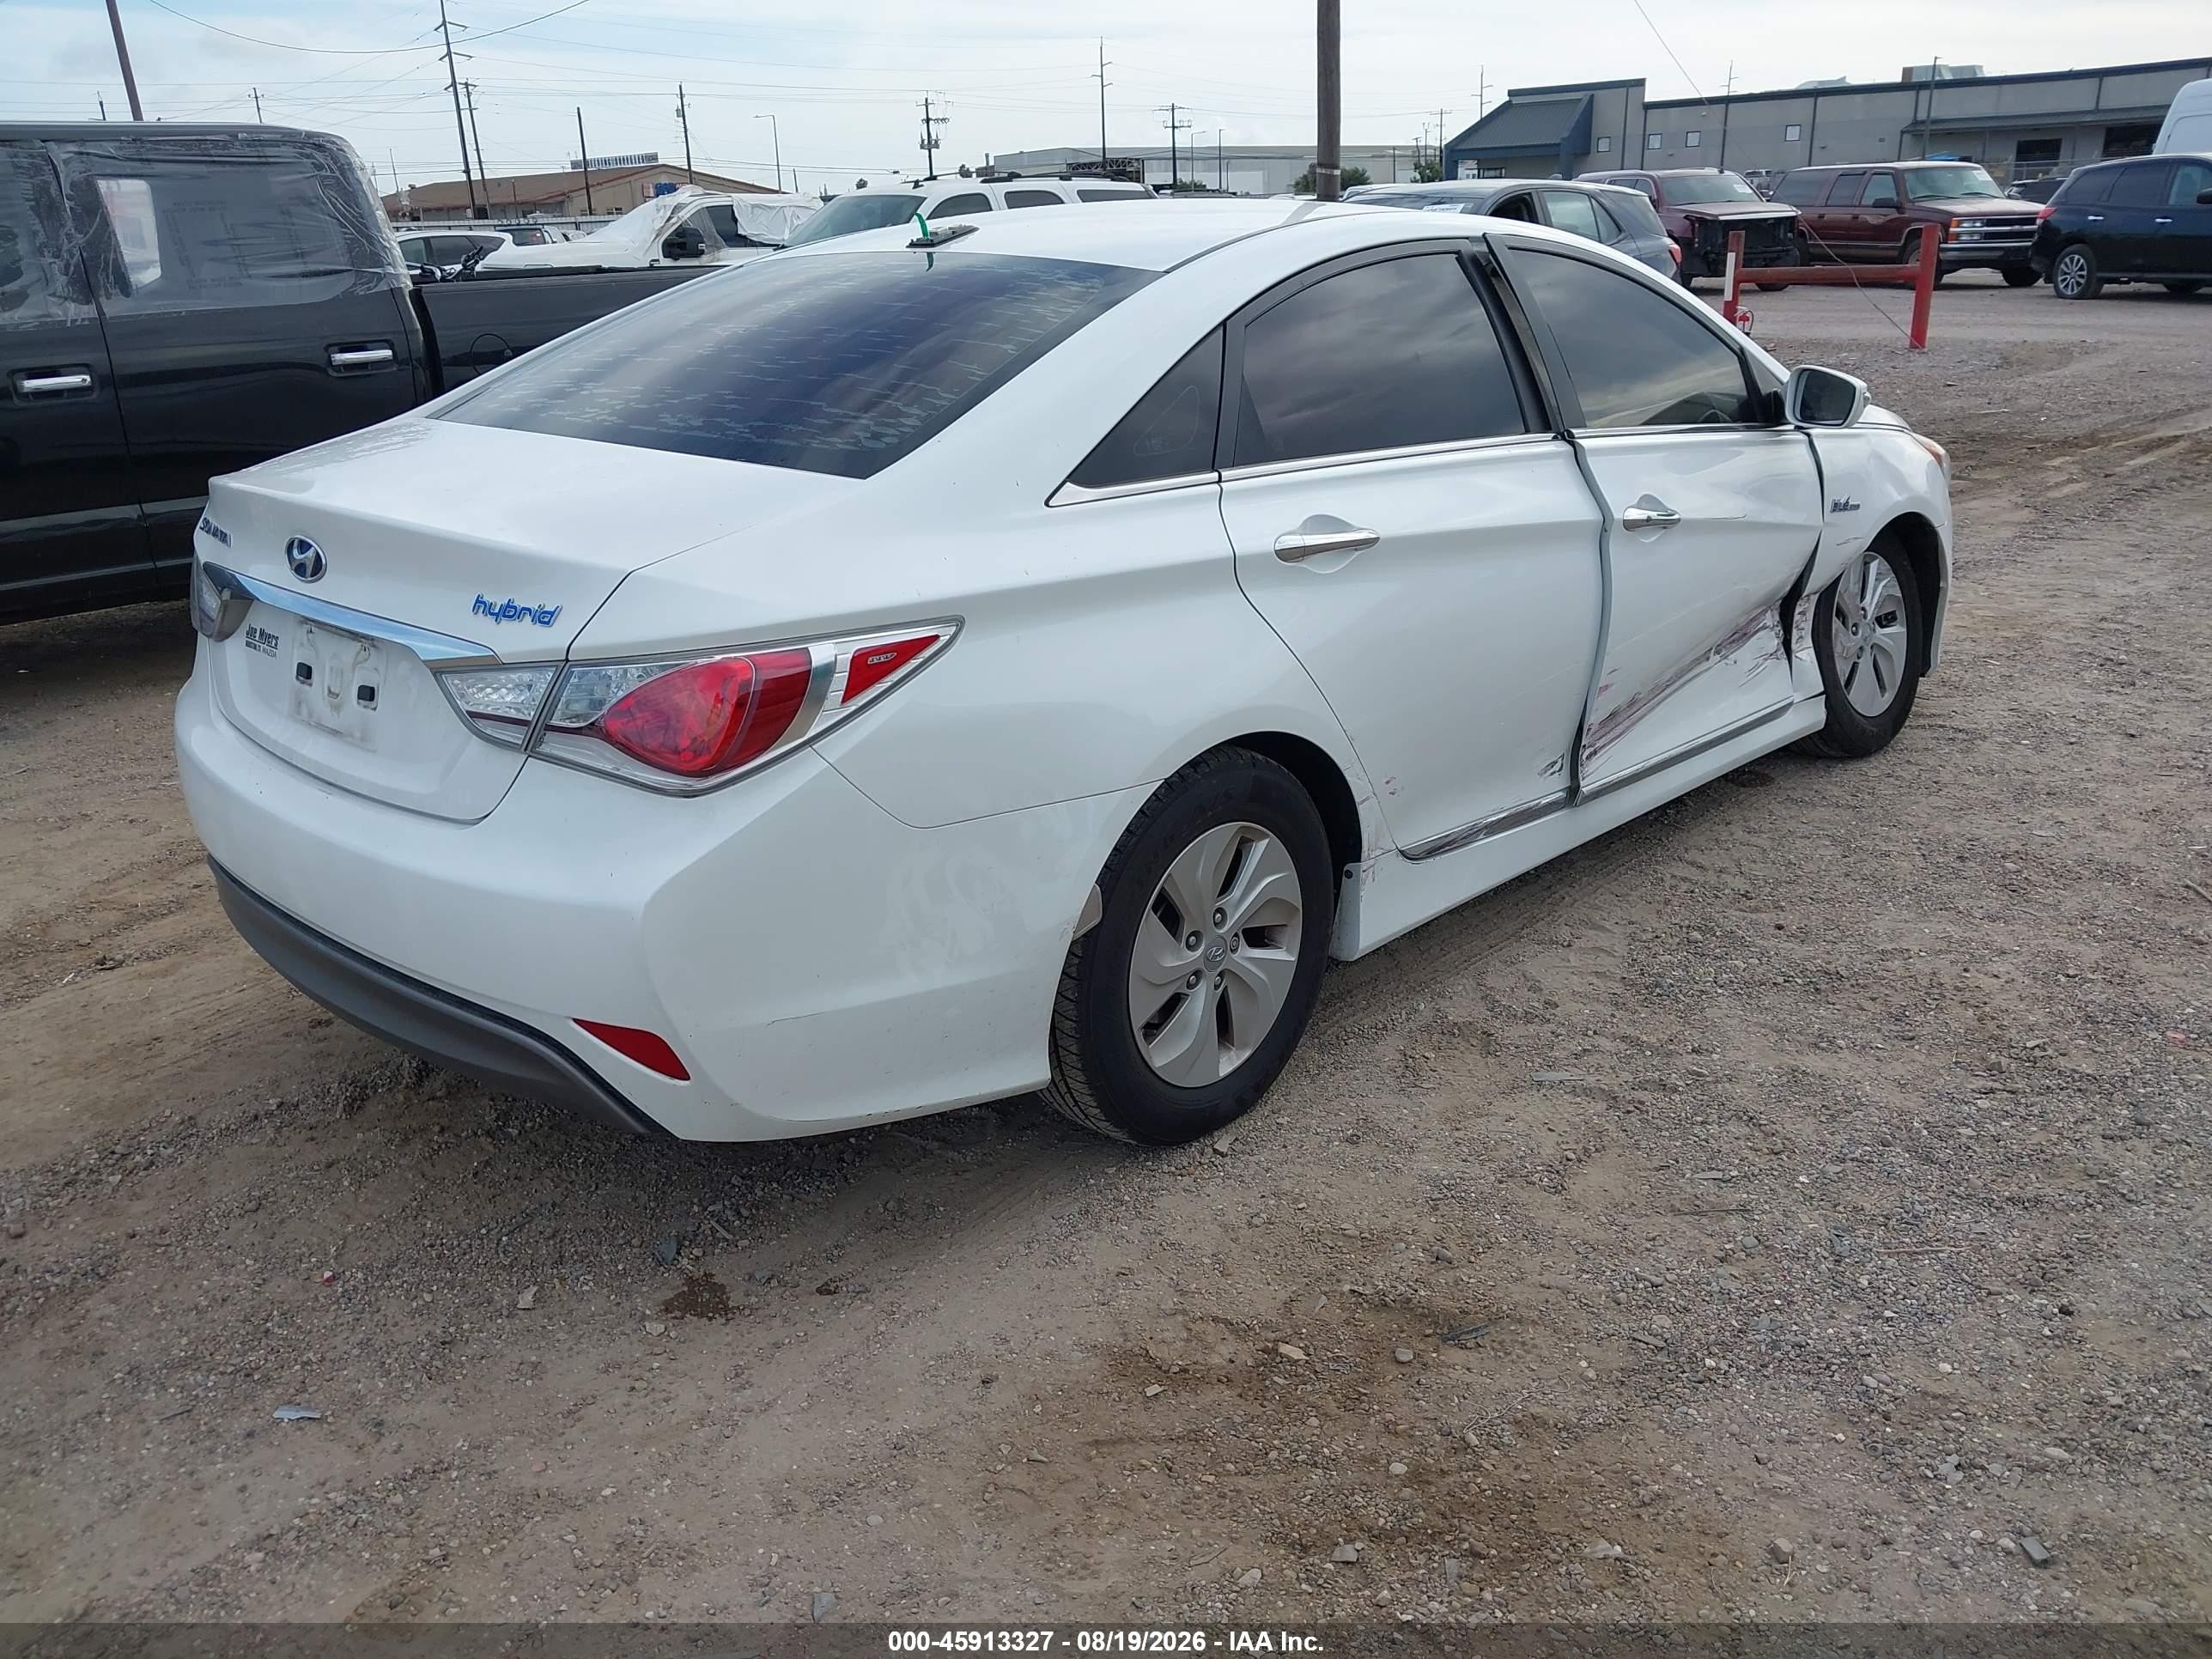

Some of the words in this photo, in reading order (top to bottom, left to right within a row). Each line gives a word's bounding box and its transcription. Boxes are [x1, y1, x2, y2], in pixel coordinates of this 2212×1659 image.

[471, 592, 562, 627] hybrid
[246, 623, 258, 638] Joe
[258, 628, 279, 647] Myers
[262, 646, 277, 659] MAZDA
